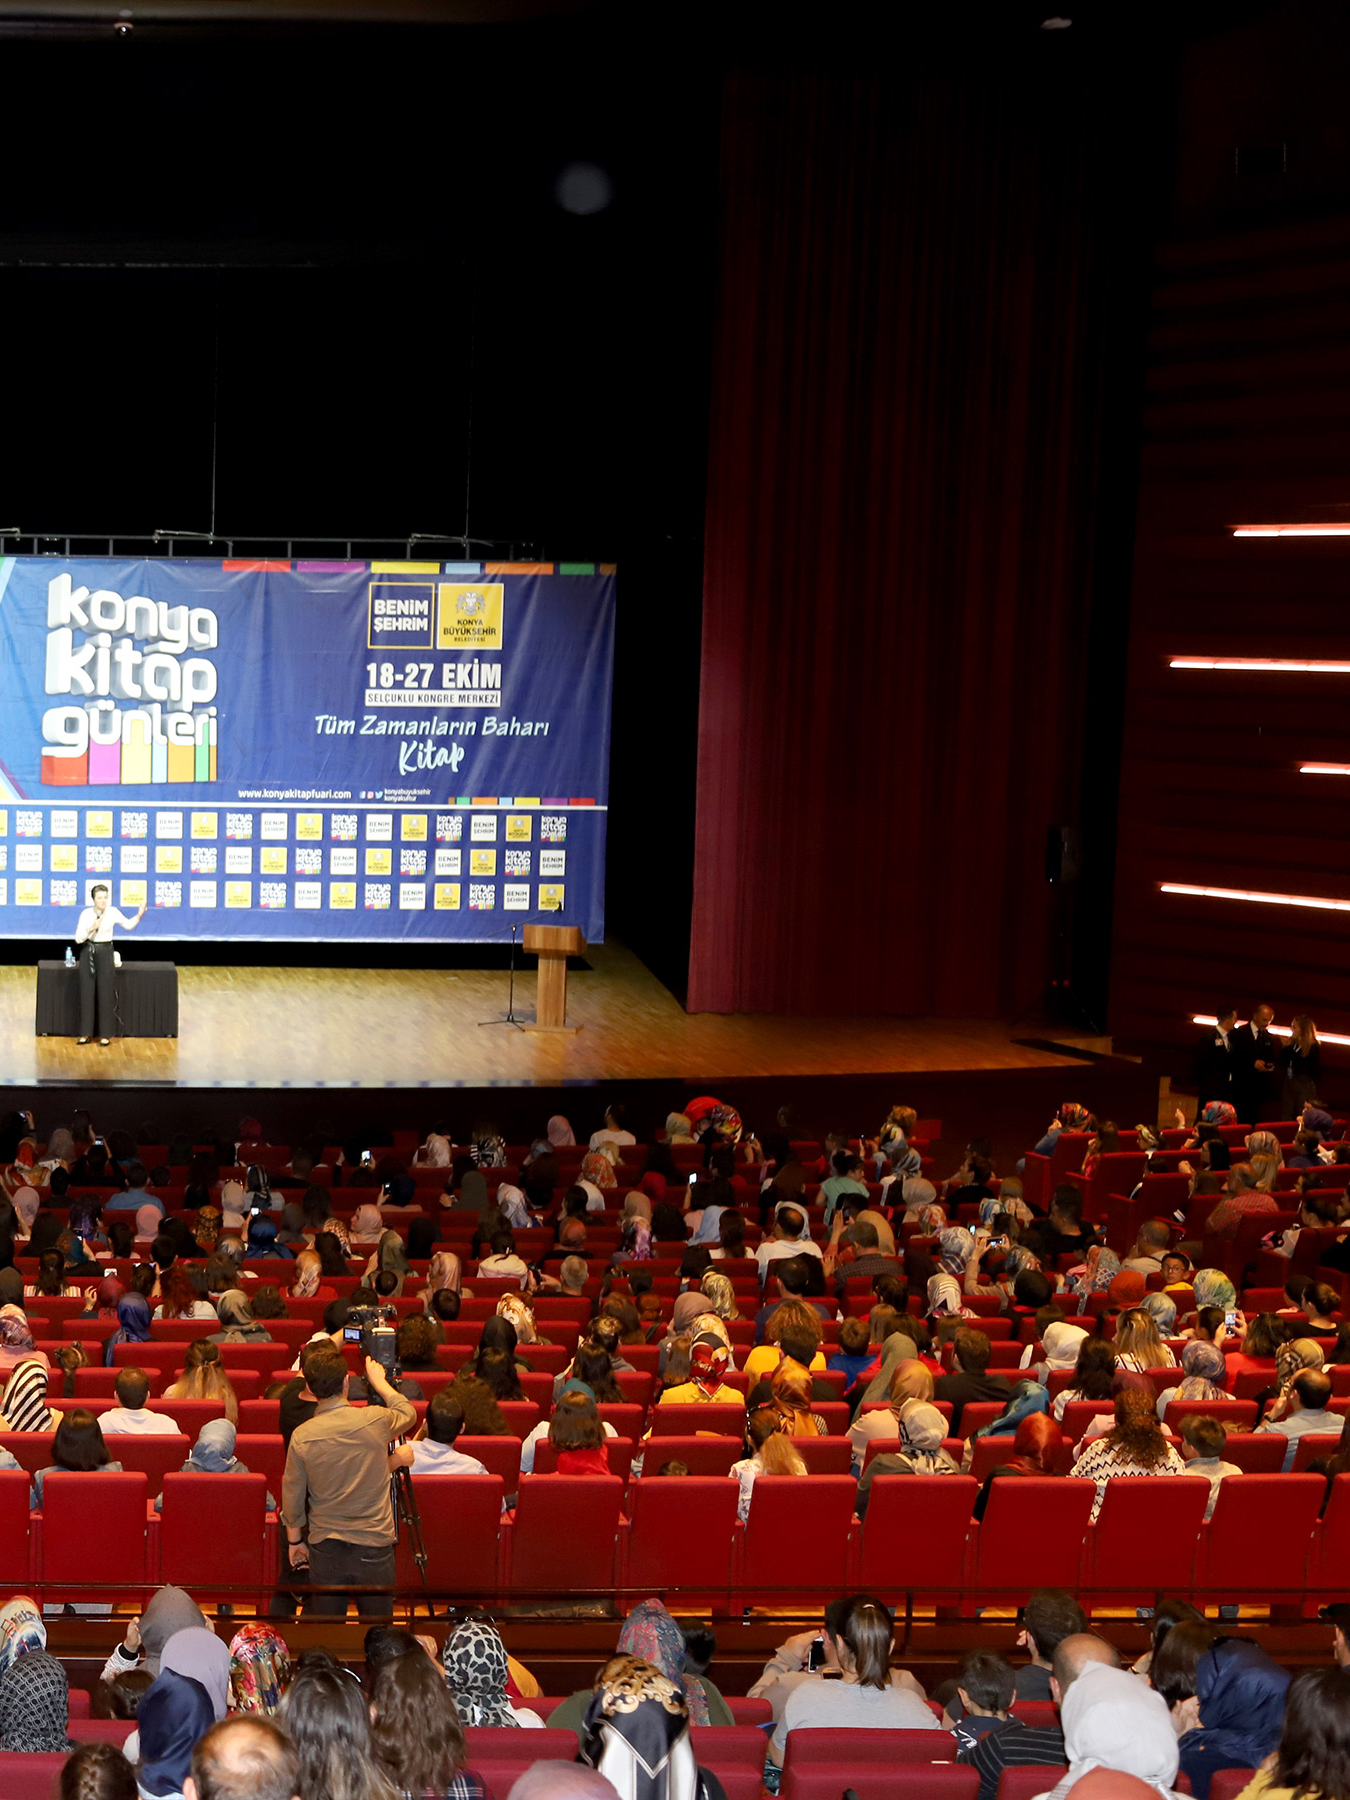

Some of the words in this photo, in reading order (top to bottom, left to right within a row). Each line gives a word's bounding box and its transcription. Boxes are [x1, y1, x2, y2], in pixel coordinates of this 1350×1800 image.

[47, 573, 218, 654] konya
[374, 599, 428, 615] BENİM
[374, 617, 428, 632] ŞEHRİM
[45, 627, 217, 712] kitap
[366, 662, 434, 688] 18-27
[442, 658, 502, 688] EKİM
[368, 693, 414, 704] SELÇUKLU
[418, 694, 454, 704] KONGRE
[458, 692, 498, 704] MERKEZİ
[41, 700, 218, 758] günleri
[315, 715, 356, 734] Tüm
[360, 716, 476, 736] Zamanların
[482, 716, 550, 736] Baharı
[399, 739, 464, 775] Kitap
[238, 789, 352, 800] www.konyakitapfuari.com
